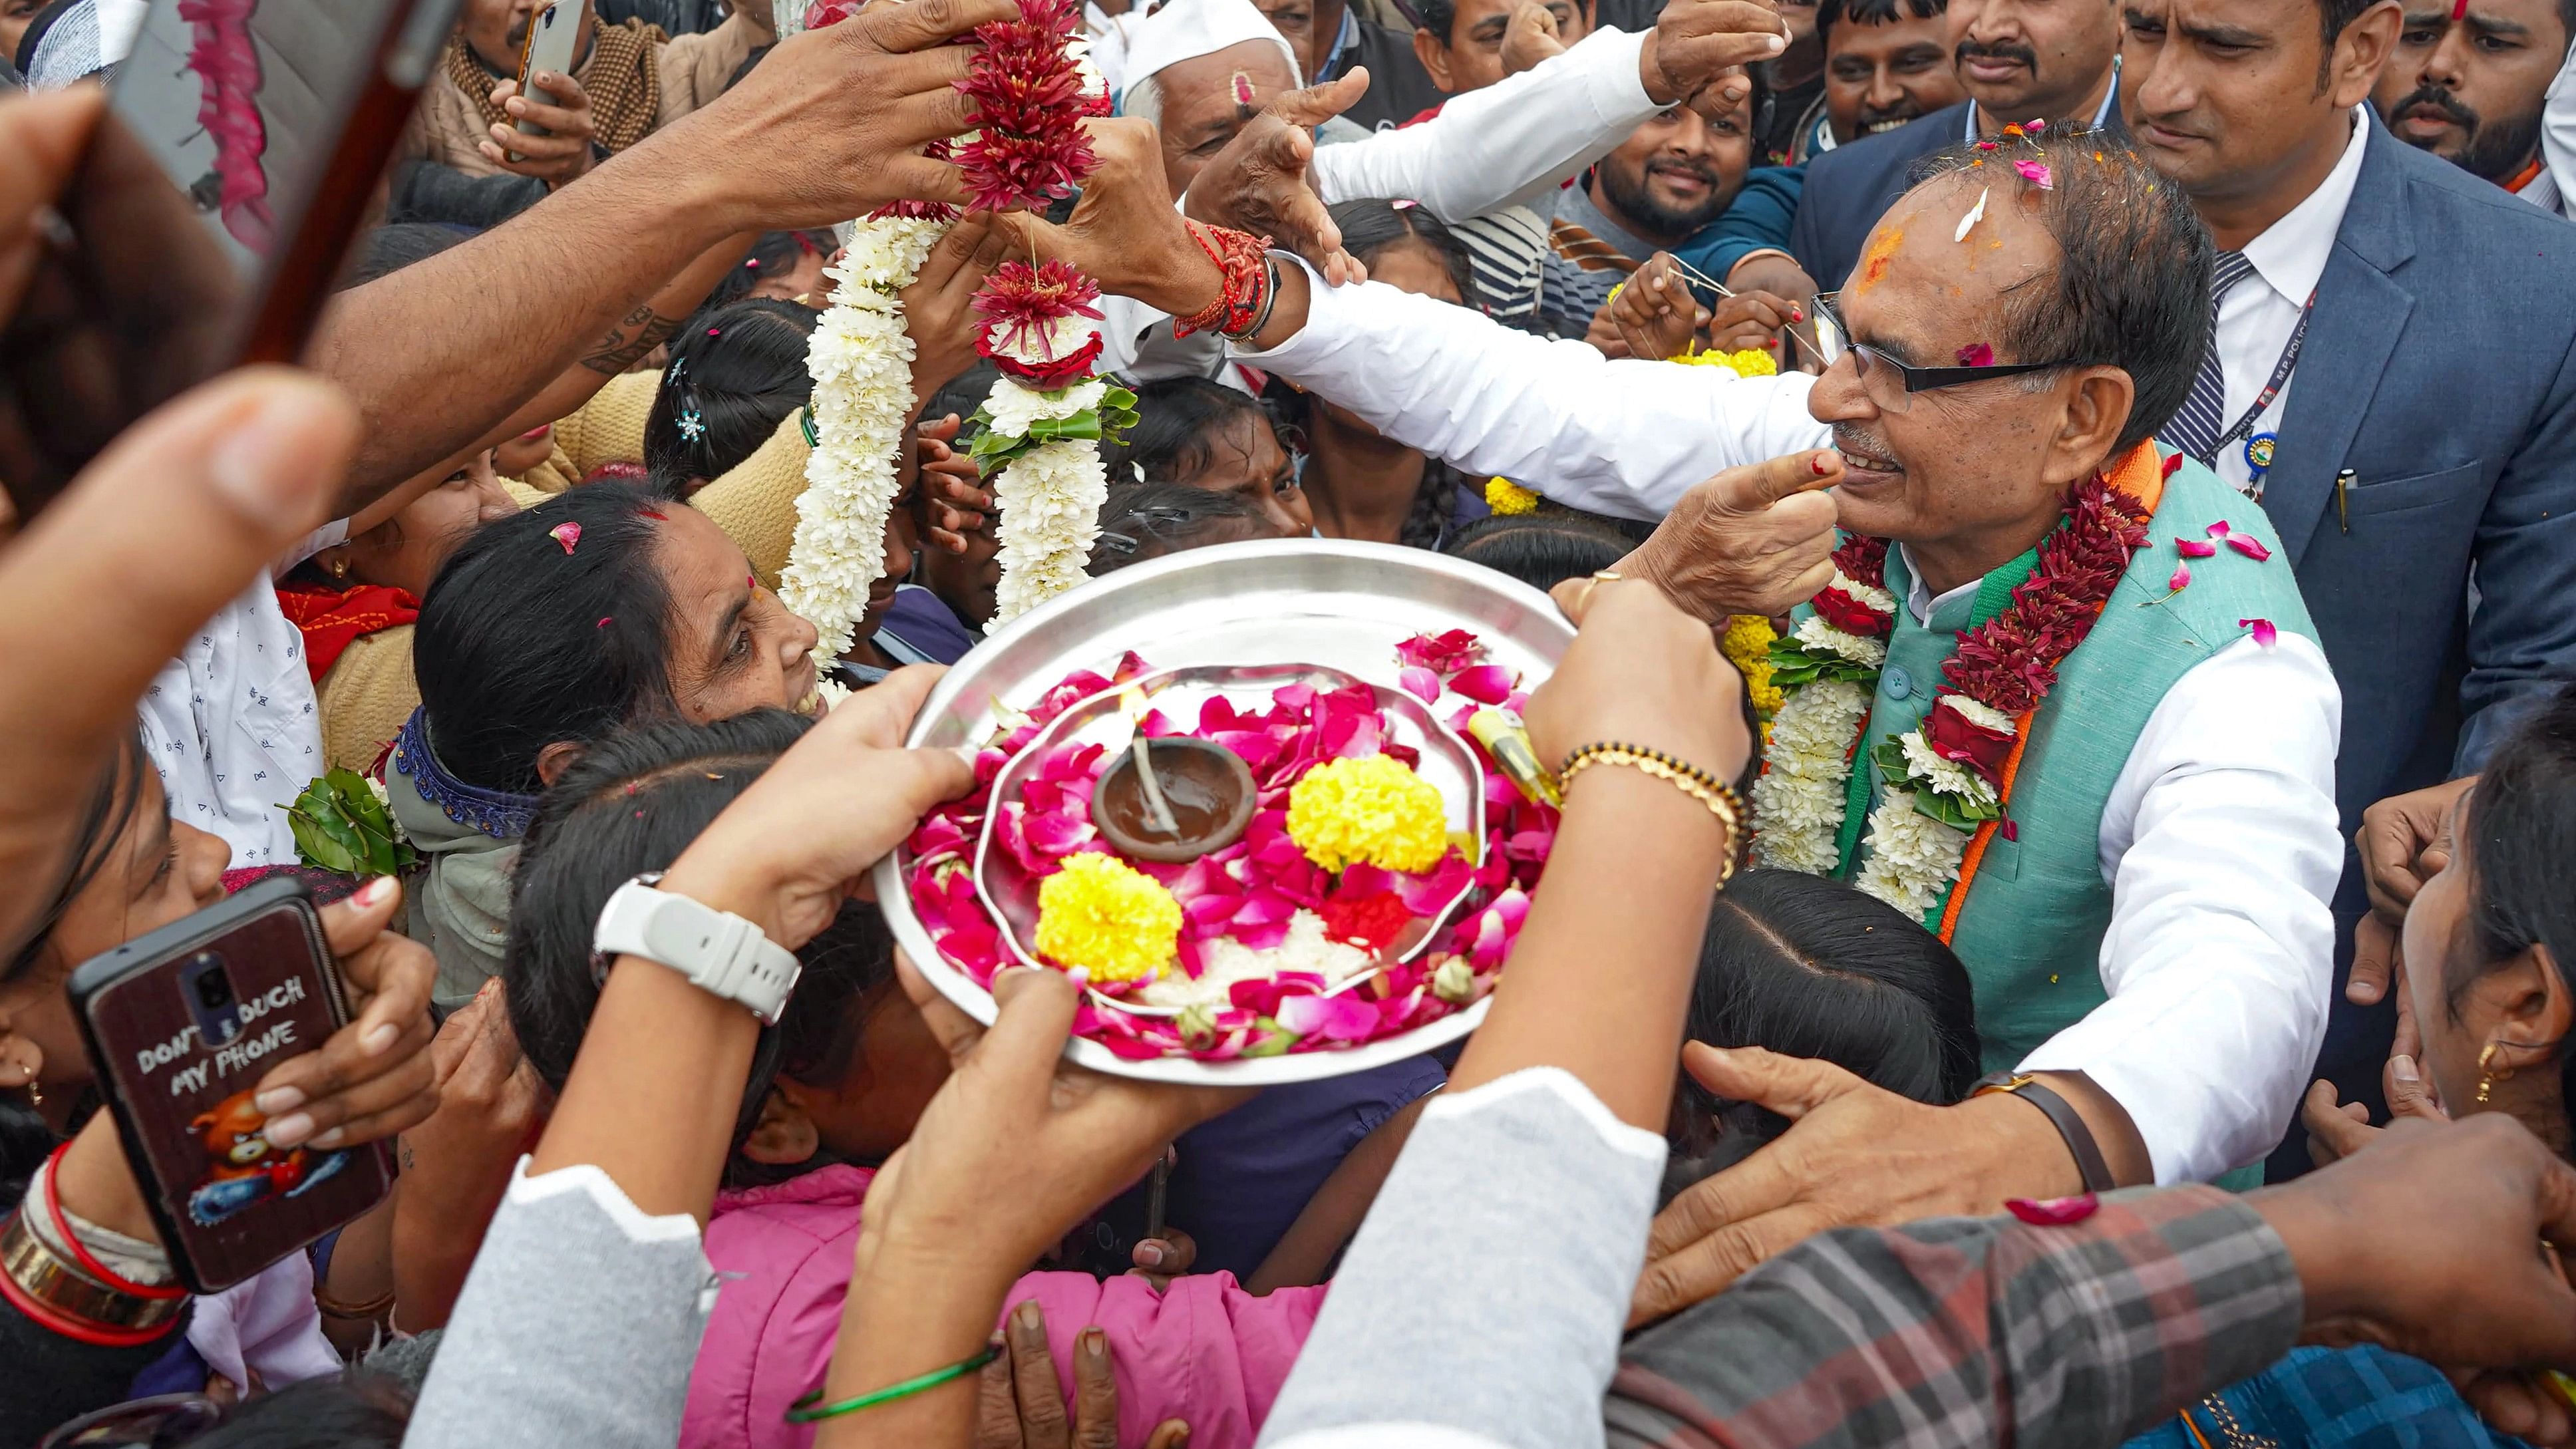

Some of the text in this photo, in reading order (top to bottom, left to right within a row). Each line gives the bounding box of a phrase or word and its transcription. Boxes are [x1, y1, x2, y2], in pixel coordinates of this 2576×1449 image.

[2277, 360, 2292, 381] M.P.
[2213, 410, 2256, 452] SECURITY
[237, 975, 306, 1024] OUCH
[171, 1020, 297, 1096] MY PHONE
